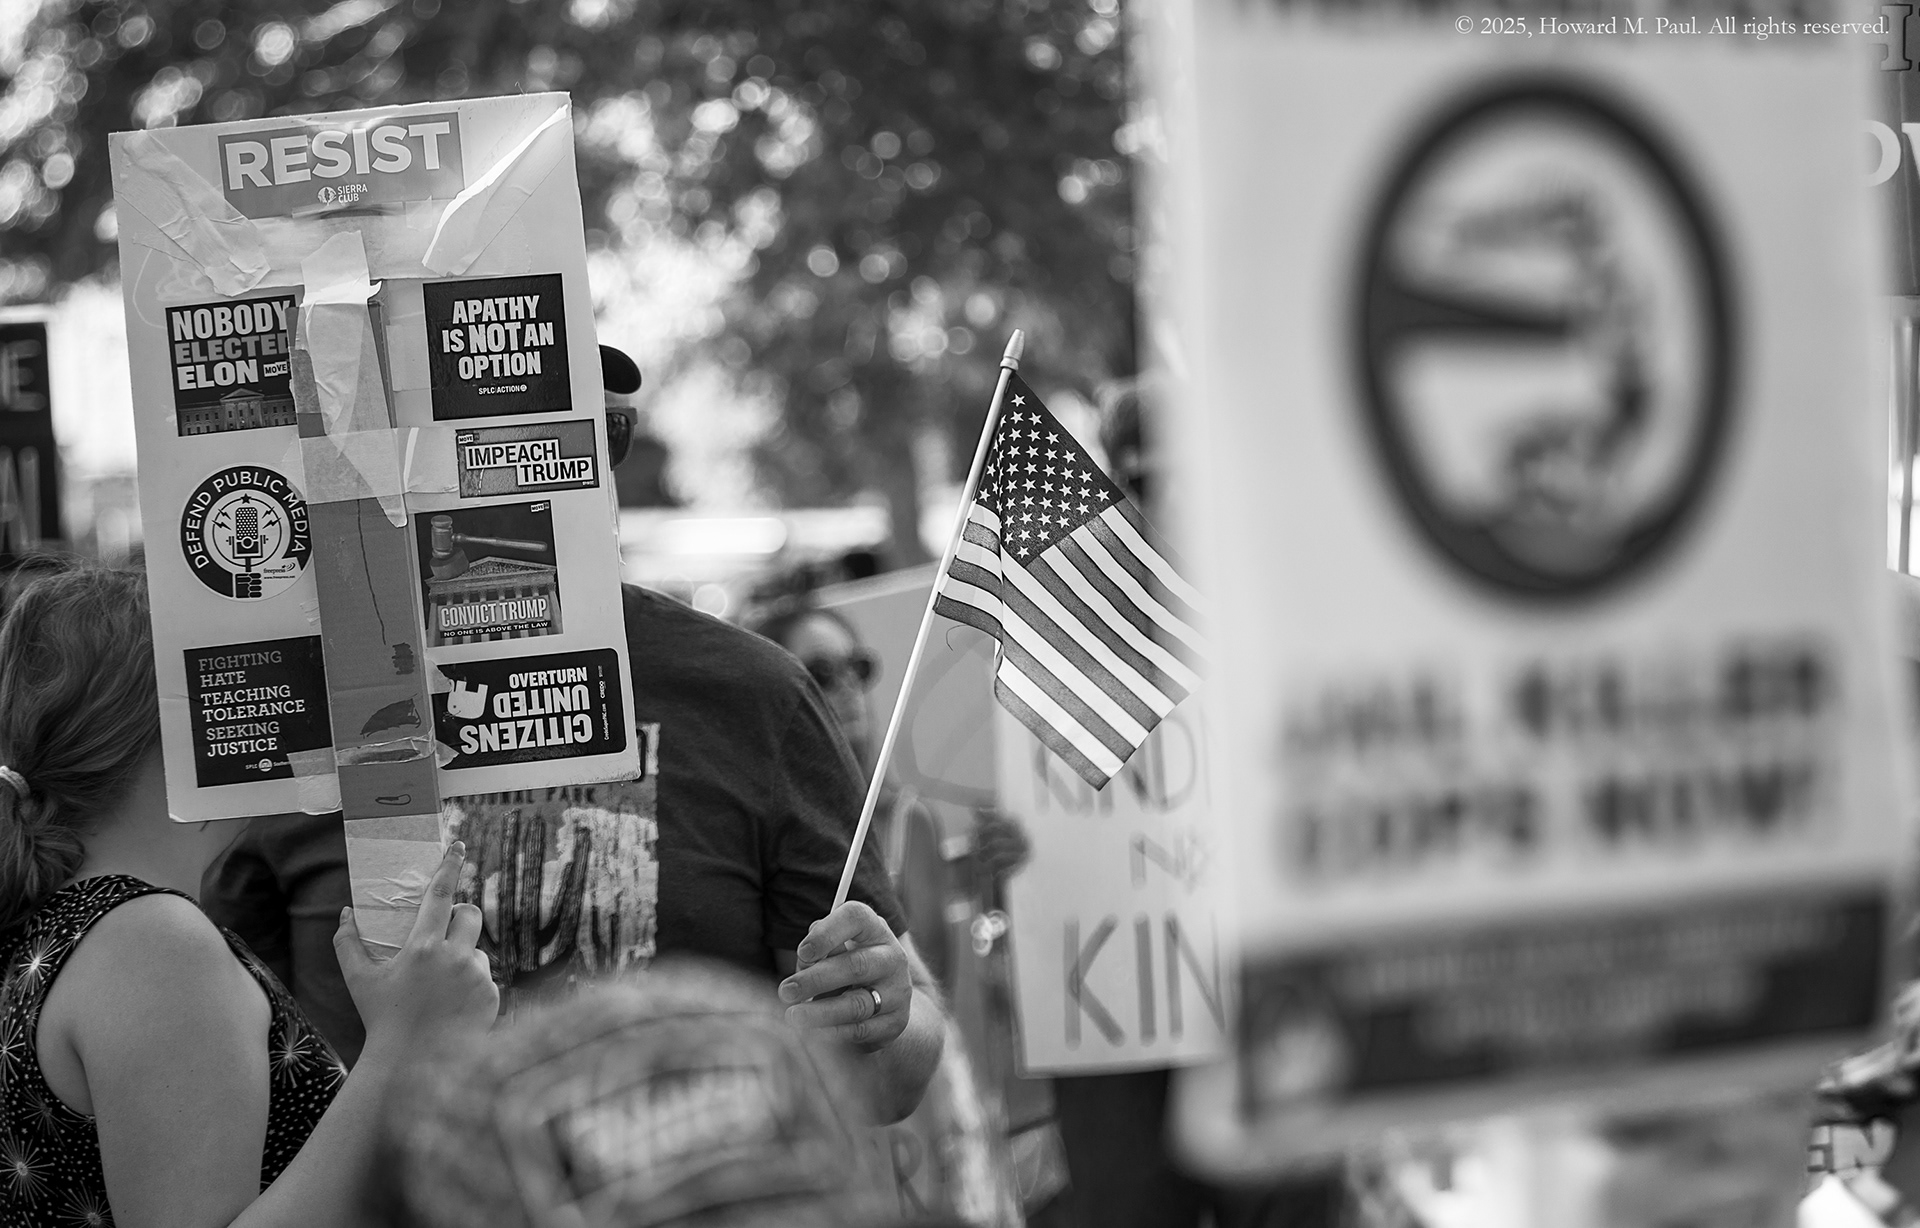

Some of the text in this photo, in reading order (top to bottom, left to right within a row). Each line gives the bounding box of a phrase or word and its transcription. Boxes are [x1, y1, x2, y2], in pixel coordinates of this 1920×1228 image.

[224, 121, 452, 191] RESIST
[337, 183, 368, 195] SIERRA
[338, 193, 360, 203] CLUB
[171, 300, 291, 342] NOBODY
[452, 295, 540, 324] APATHY
[442, 321, 554, 354] IS NOT AN
[177, 359, 259, 390] ELON
[458, 351, 542, 380] OPTION
[478, 385, 520, 395] SPLC ACTION
[468, 442, 557, 467] IMPEACH
[520, 460, 589, 482] TRUMP
[186, 471, 308, 569] DEFEND PUBLIC MEDIA
[441, 598, 547, 628] CONVICT TRUMP
[485, 625, 512, 633] ABOVE
[198, 650, 283, 672] FIGHTING
[200, 670, 247, 688] HATE
[508, 666, 588, 689] OVERTURN
[201, 684, 291, 706] TEACHING
[202, 699, 306, 723] TOLERANCE
[459, 684, 594, 755] CITIZENS UNITED
[206, 721, 280, 741] SEEKING
[207, 737, 278, 757] JUSTICE
